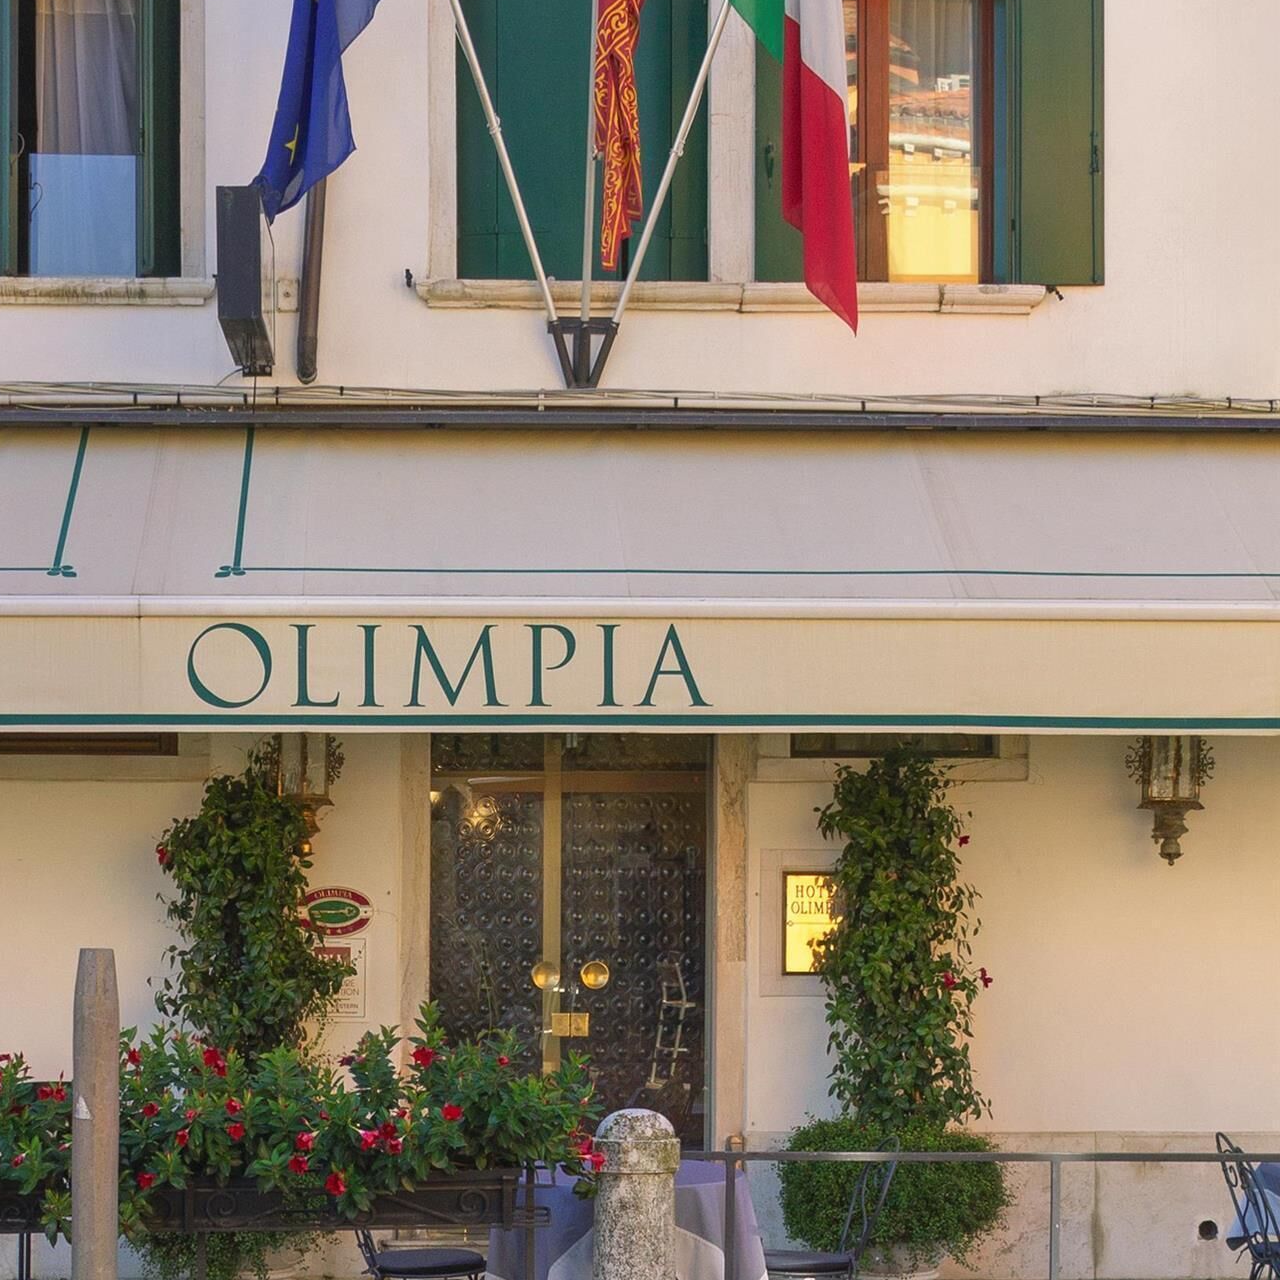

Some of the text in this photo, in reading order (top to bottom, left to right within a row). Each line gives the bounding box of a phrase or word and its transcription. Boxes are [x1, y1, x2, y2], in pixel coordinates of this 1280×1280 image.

[187, 622, 714, 709] OLIMPIA
[795, 884, 830, 898] HOT
[791, 901, 830, 914] OLIM
